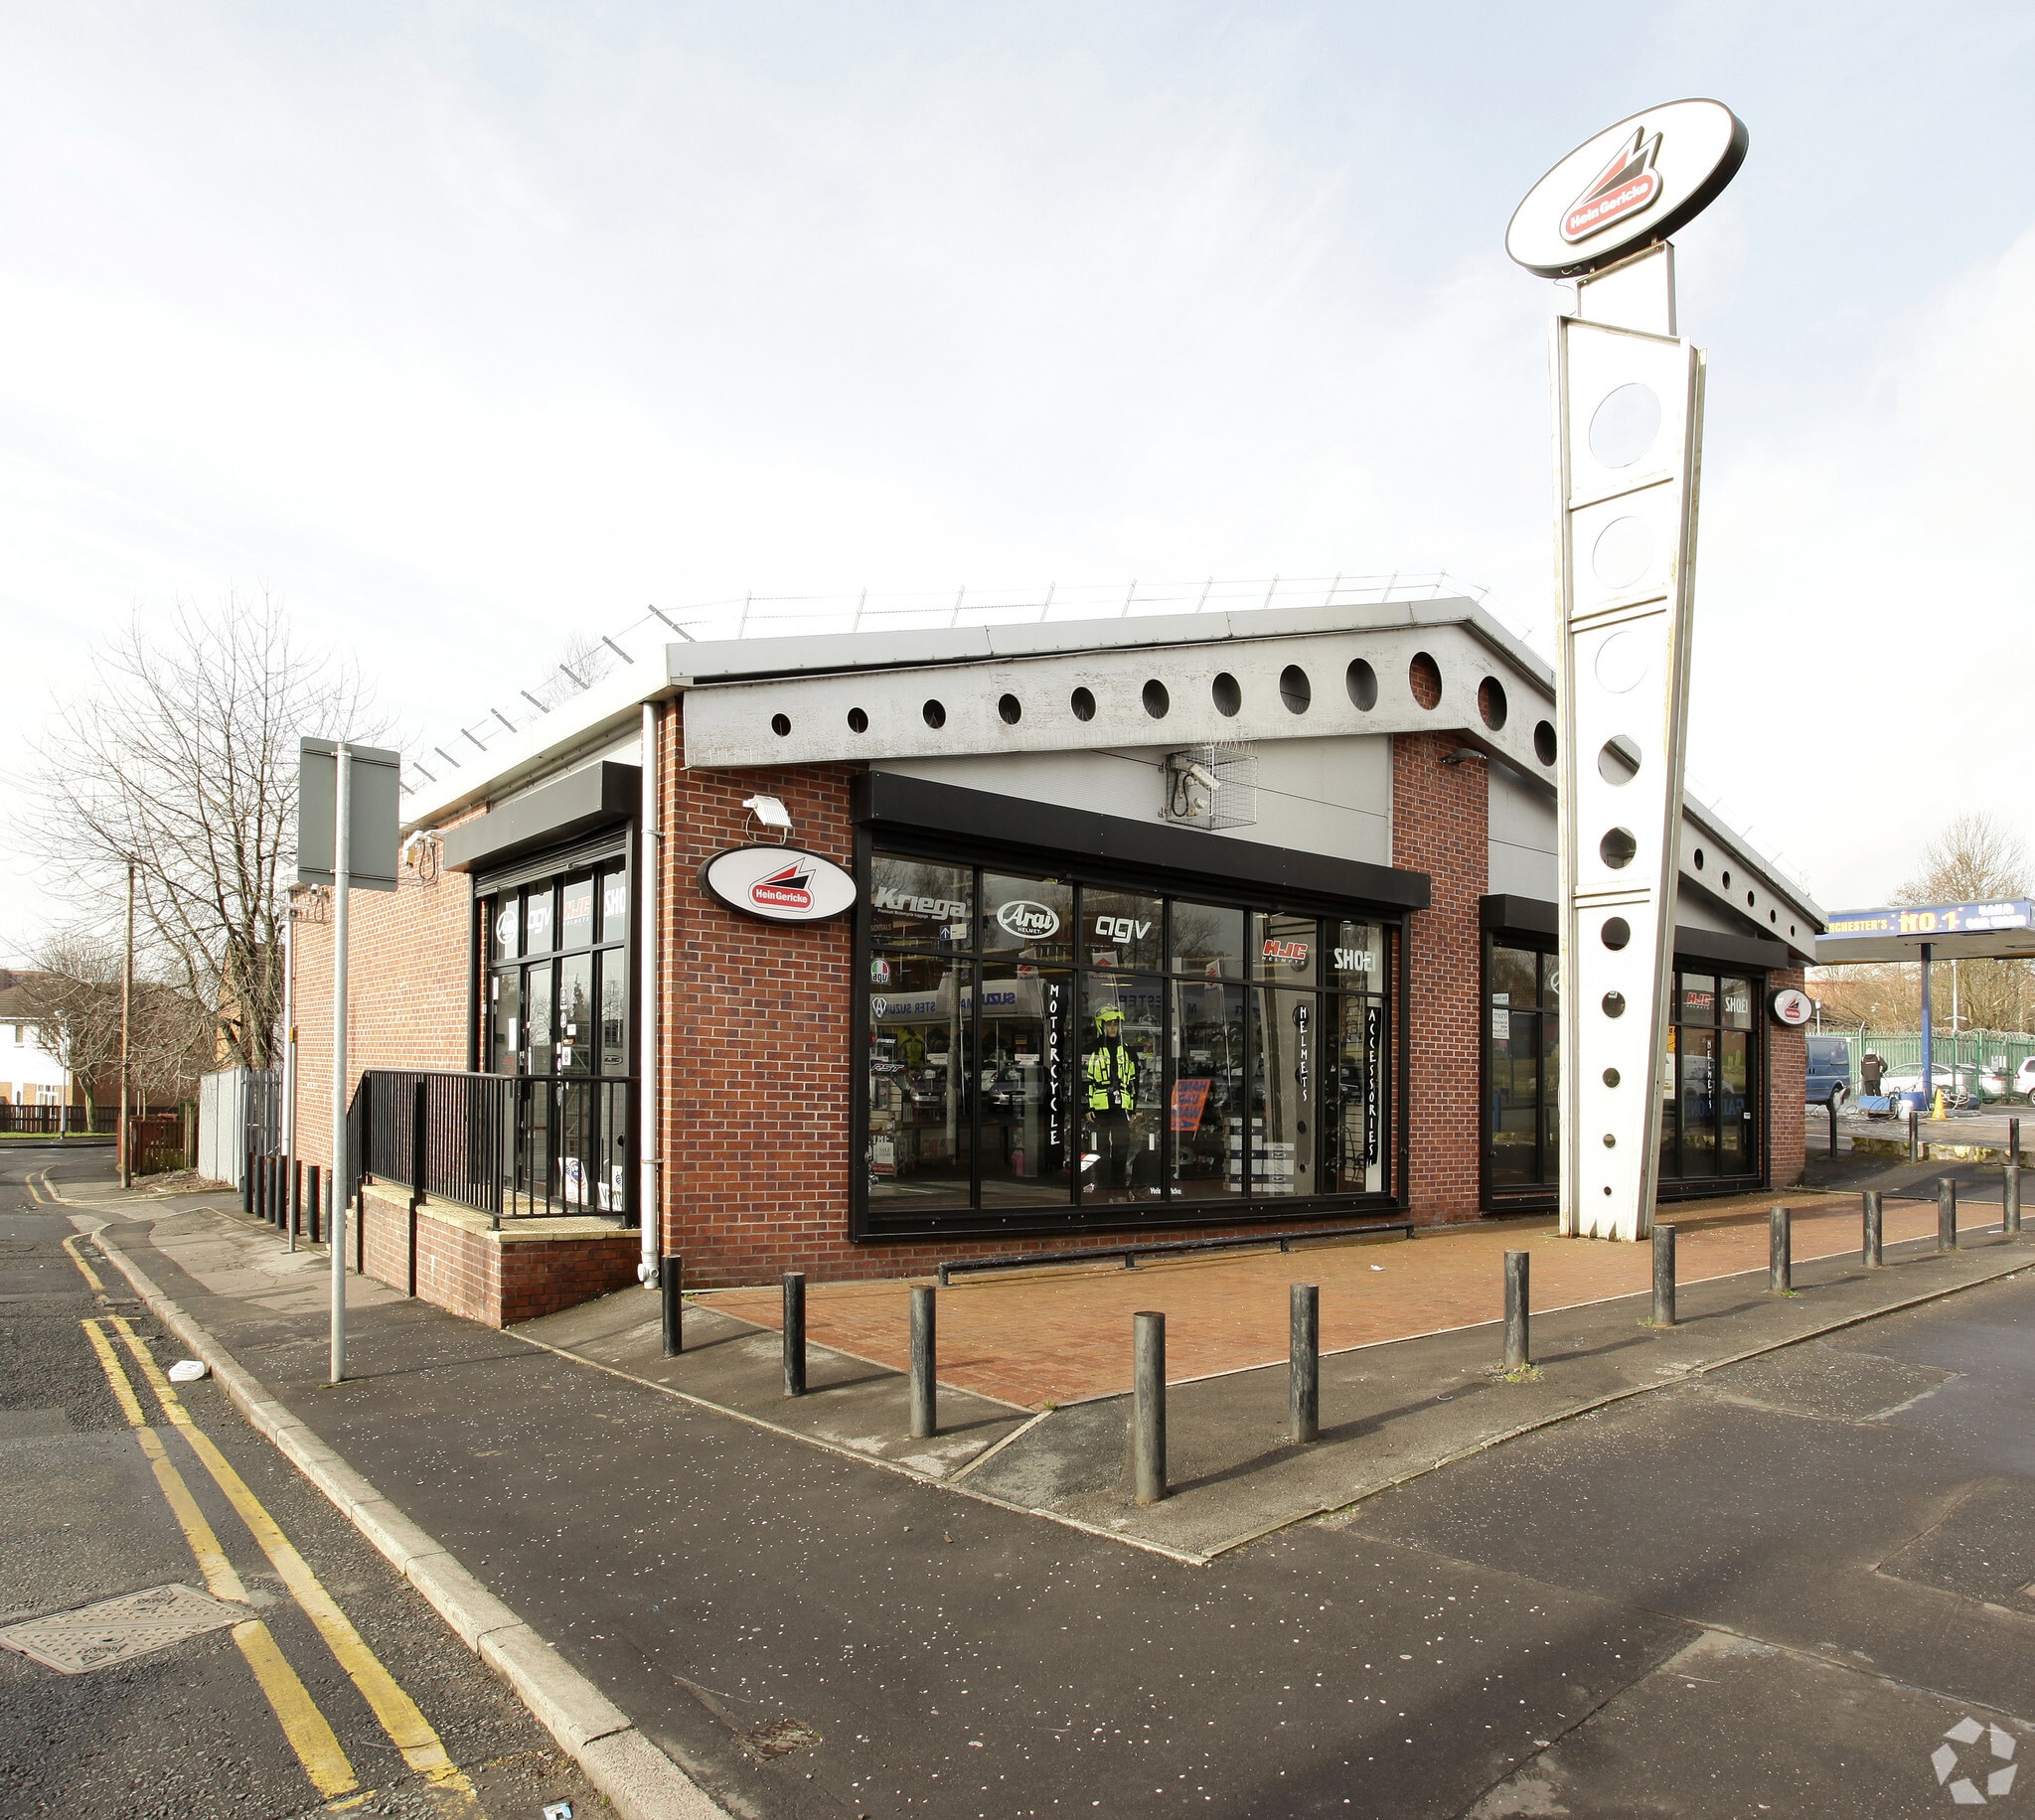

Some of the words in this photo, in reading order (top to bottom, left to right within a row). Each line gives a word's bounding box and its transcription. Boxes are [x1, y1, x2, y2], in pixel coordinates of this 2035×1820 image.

[1570, 207, 1600, 229] Hein
[1599, 182, 1648, 214] Gericke
[562, 896, 591, 920] HJC
[755, 888, 776, 900] Hein
[775, 891, 808, 904] Gericke
[874, 886, 966, 921] Kriega
[1003, 904, 1053, 930] Arai
[1095, 915, 1153, 944] agv
[1262, 939, 1308, 960] HJC
[1333, 948, 1377, 973] SHOEI
[1686, 992, 1711, 1006] HJC
[1725, 996, 1749, 1013] SHOEI
[871, 1063, 905, 1073] RST
[1049, 985, 1060, 1145] MOTORCYCLE
